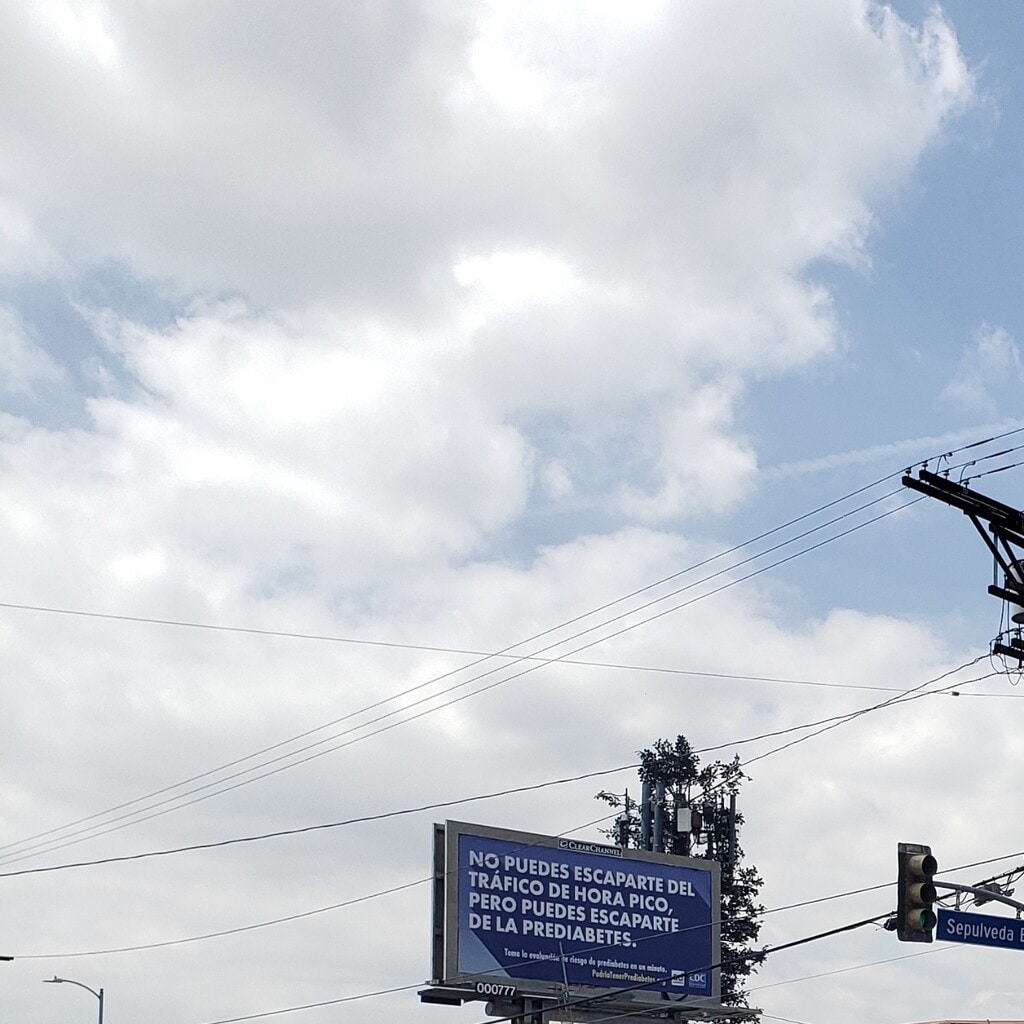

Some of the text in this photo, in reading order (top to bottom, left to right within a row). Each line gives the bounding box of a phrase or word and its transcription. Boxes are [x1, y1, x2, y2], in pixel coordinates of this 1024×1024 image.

[469, 850, 696, 897] NO PUEDES ESCAPARTE DEL
[469, 870, 673, 916] TRÁFICO DE HORA PICO,
[469, 892, 680, 933] PERO PUEDES ESCAPARTE
[946, 918, 1014, 942] Sepulveda
[469, 913, 638, 948] DE LA PREDIABETES.
[504, 947, 520, 958] Toma
[522, 948, 528, 958] la
[570, 955, 588, 966] riesgo
[588, 956, 596, 966] de
[597, 958, 630, 970] prediabetes
[477, 982, 516, 997] 000777
